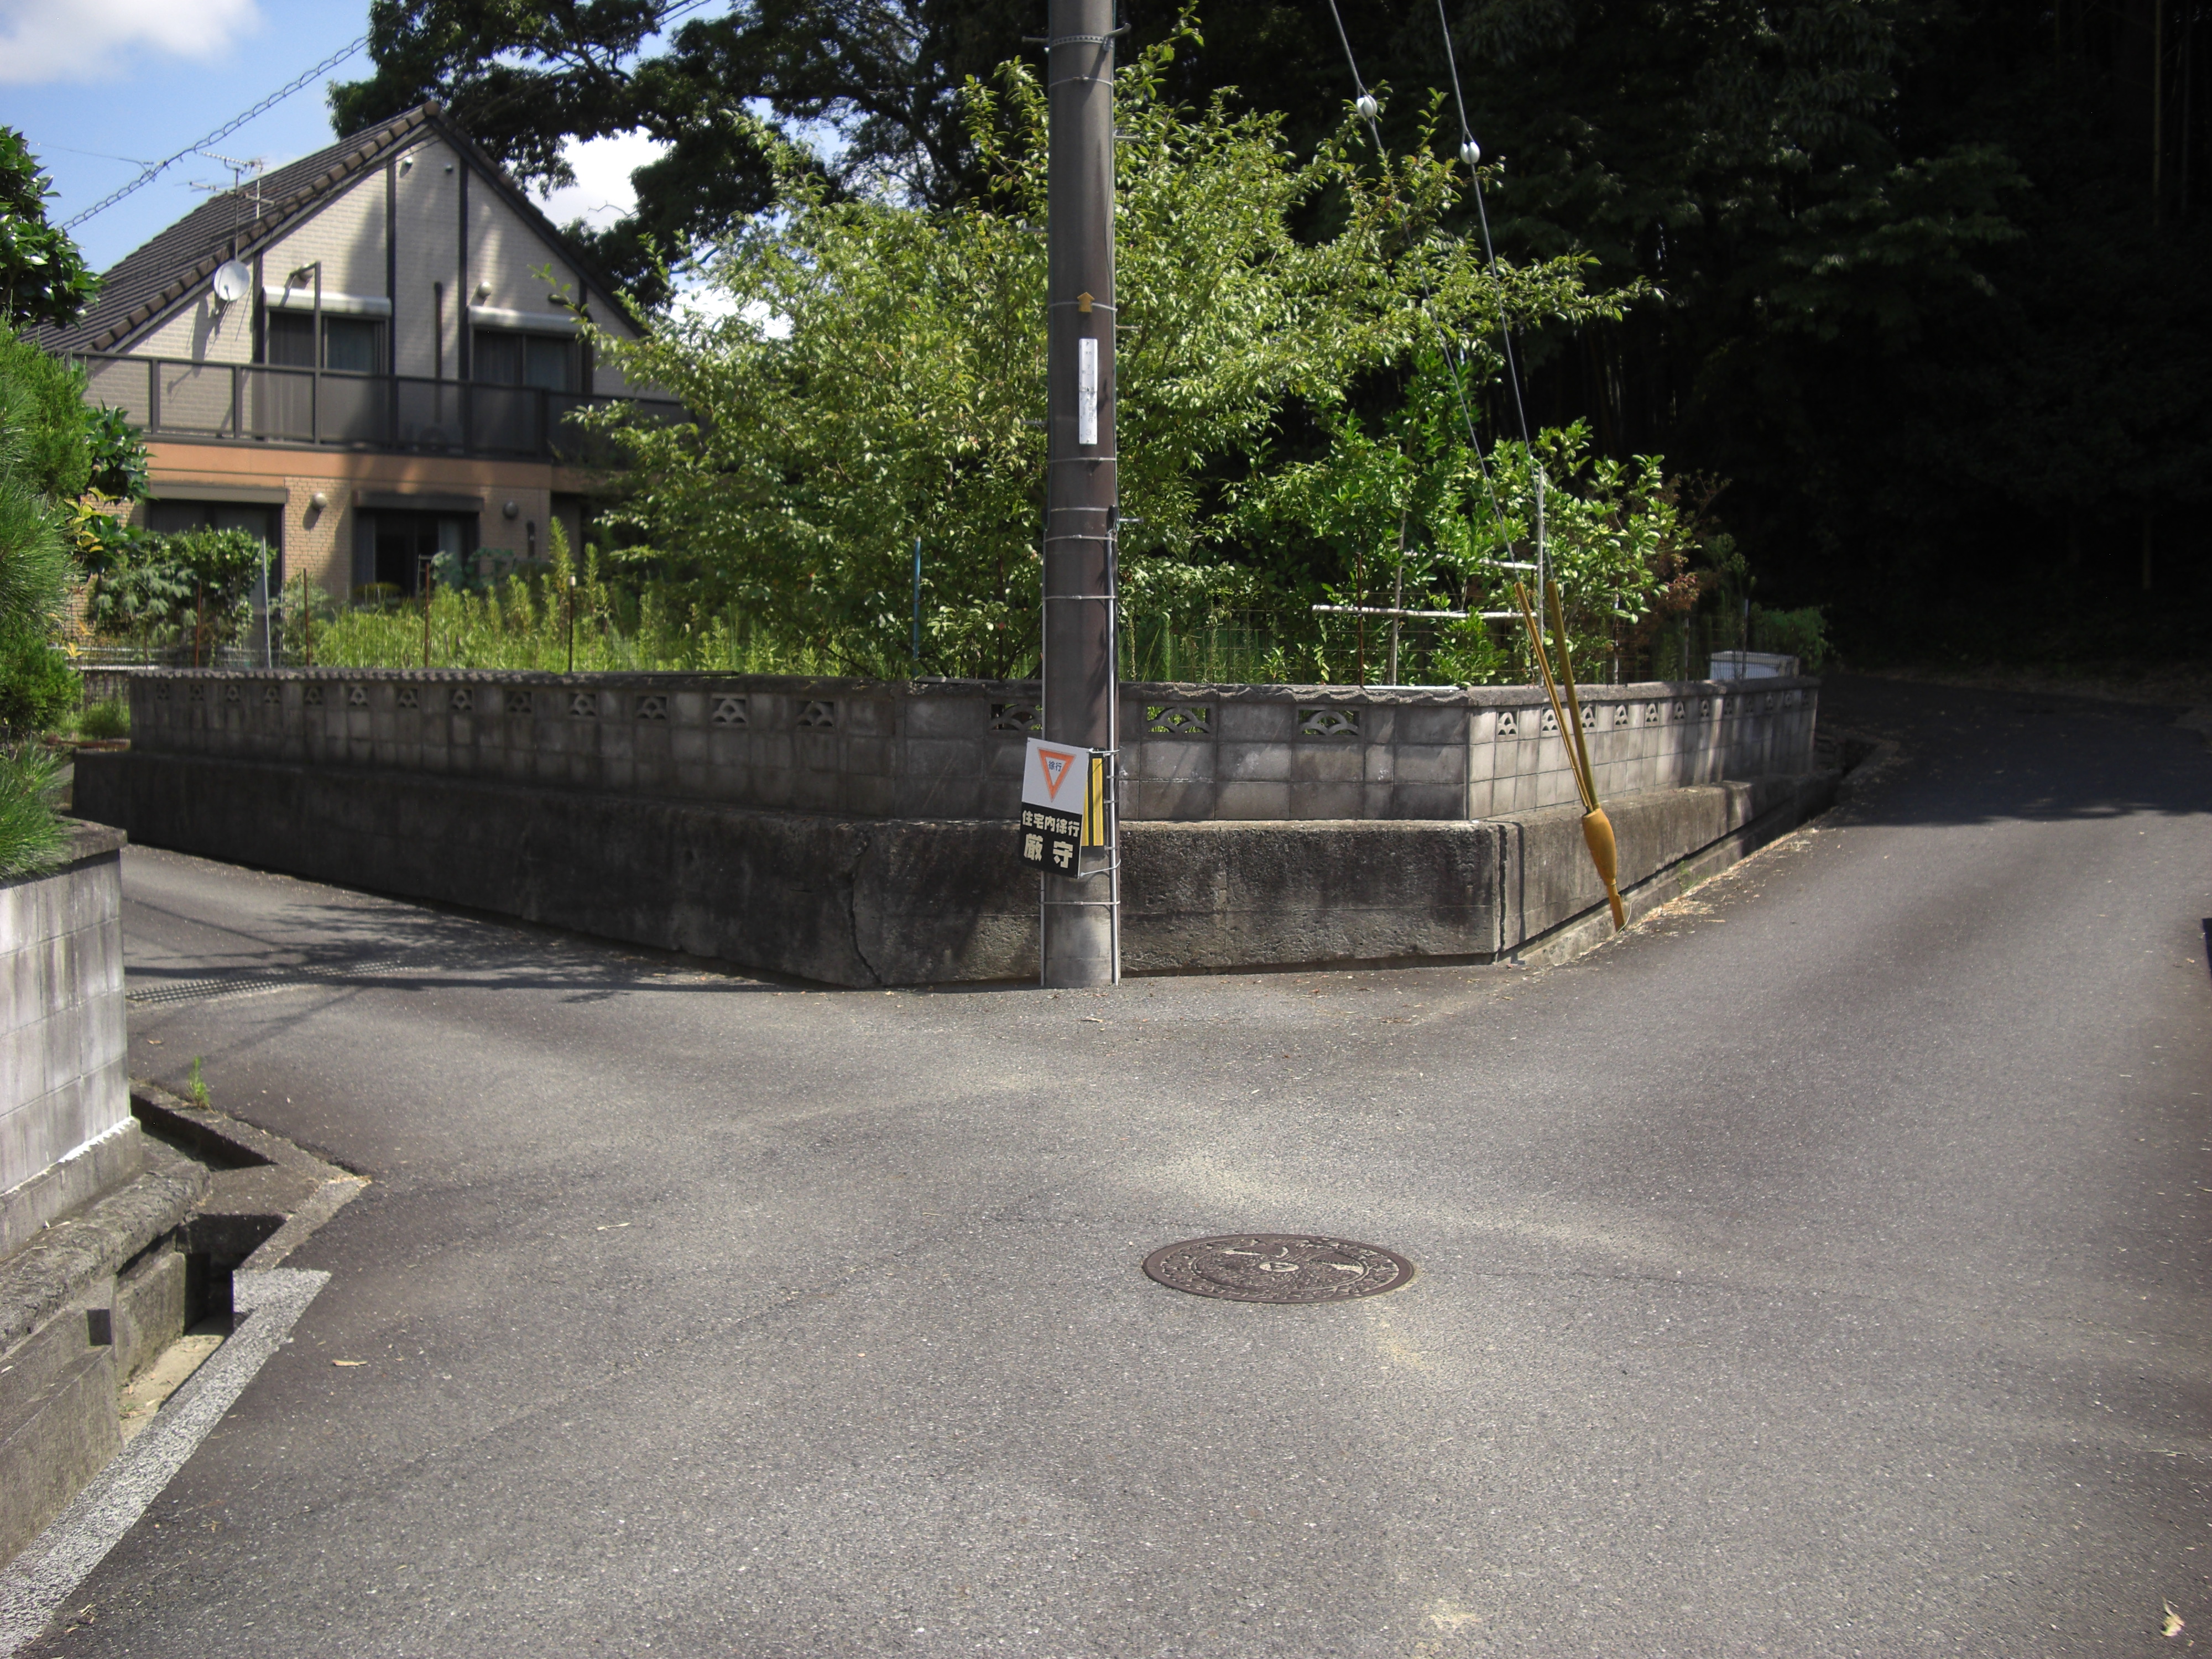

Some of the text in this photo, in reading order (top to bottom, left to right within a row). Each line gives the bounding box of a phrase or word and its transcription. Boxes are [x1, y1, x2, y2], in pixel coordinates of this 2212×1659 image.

[1048, 760, 1062, 771] 徐行
[1022, 810, 1079, 837] 住宅内徐行
